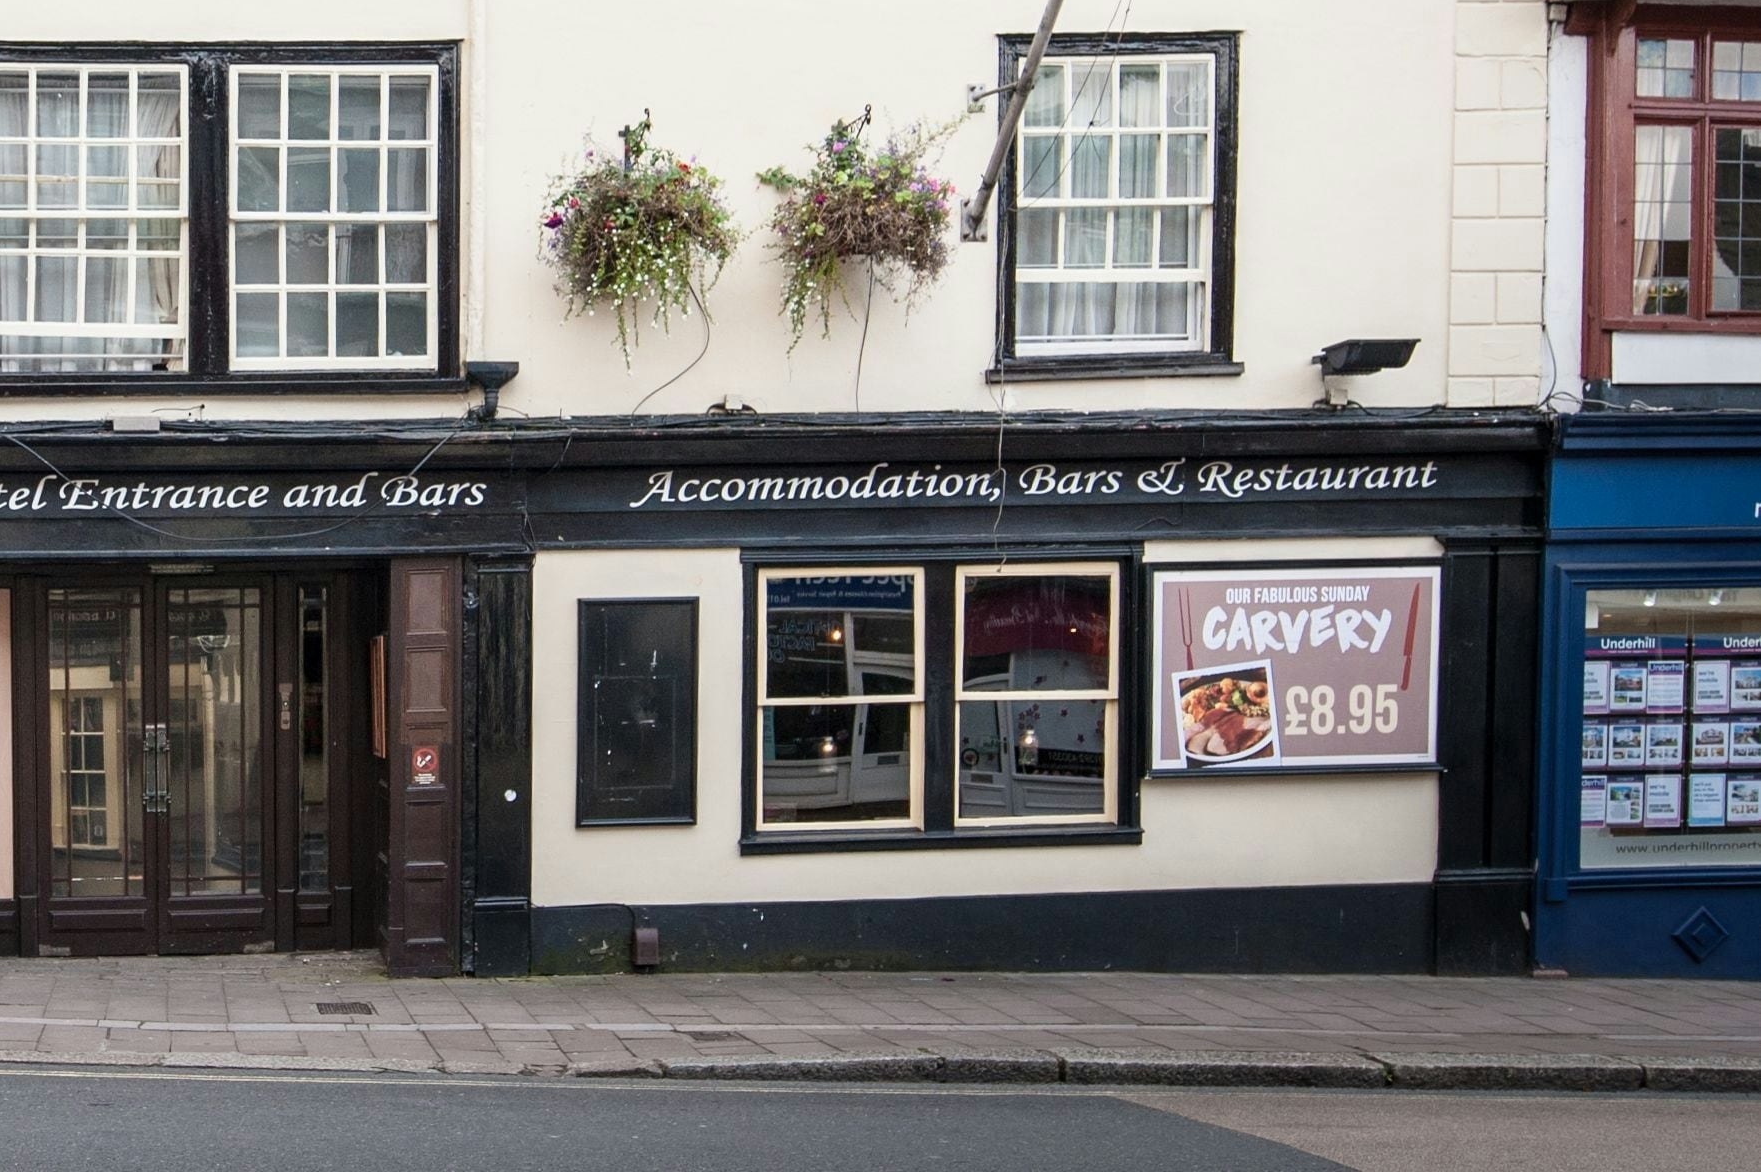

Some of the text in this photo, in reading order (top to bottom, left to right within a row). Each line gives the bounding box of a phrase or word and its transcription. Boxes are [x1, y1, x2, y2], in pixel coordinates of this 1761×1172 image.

[58, 478, 270, 511] Entrance
[283, 471, 379, 508] and
[380, 475, 487, 507] Bars
[629, 457, 1439, 508] Accommodation, Bars & Restaurant
[1226, 585, 1370, 605] OUR FABULOUS SUNDAY
[1202, 604, 1392, 656] CARVERY
[1600, 635, 1656, 649] Underhill
[1284, 683, 1399, 736] £8.95
